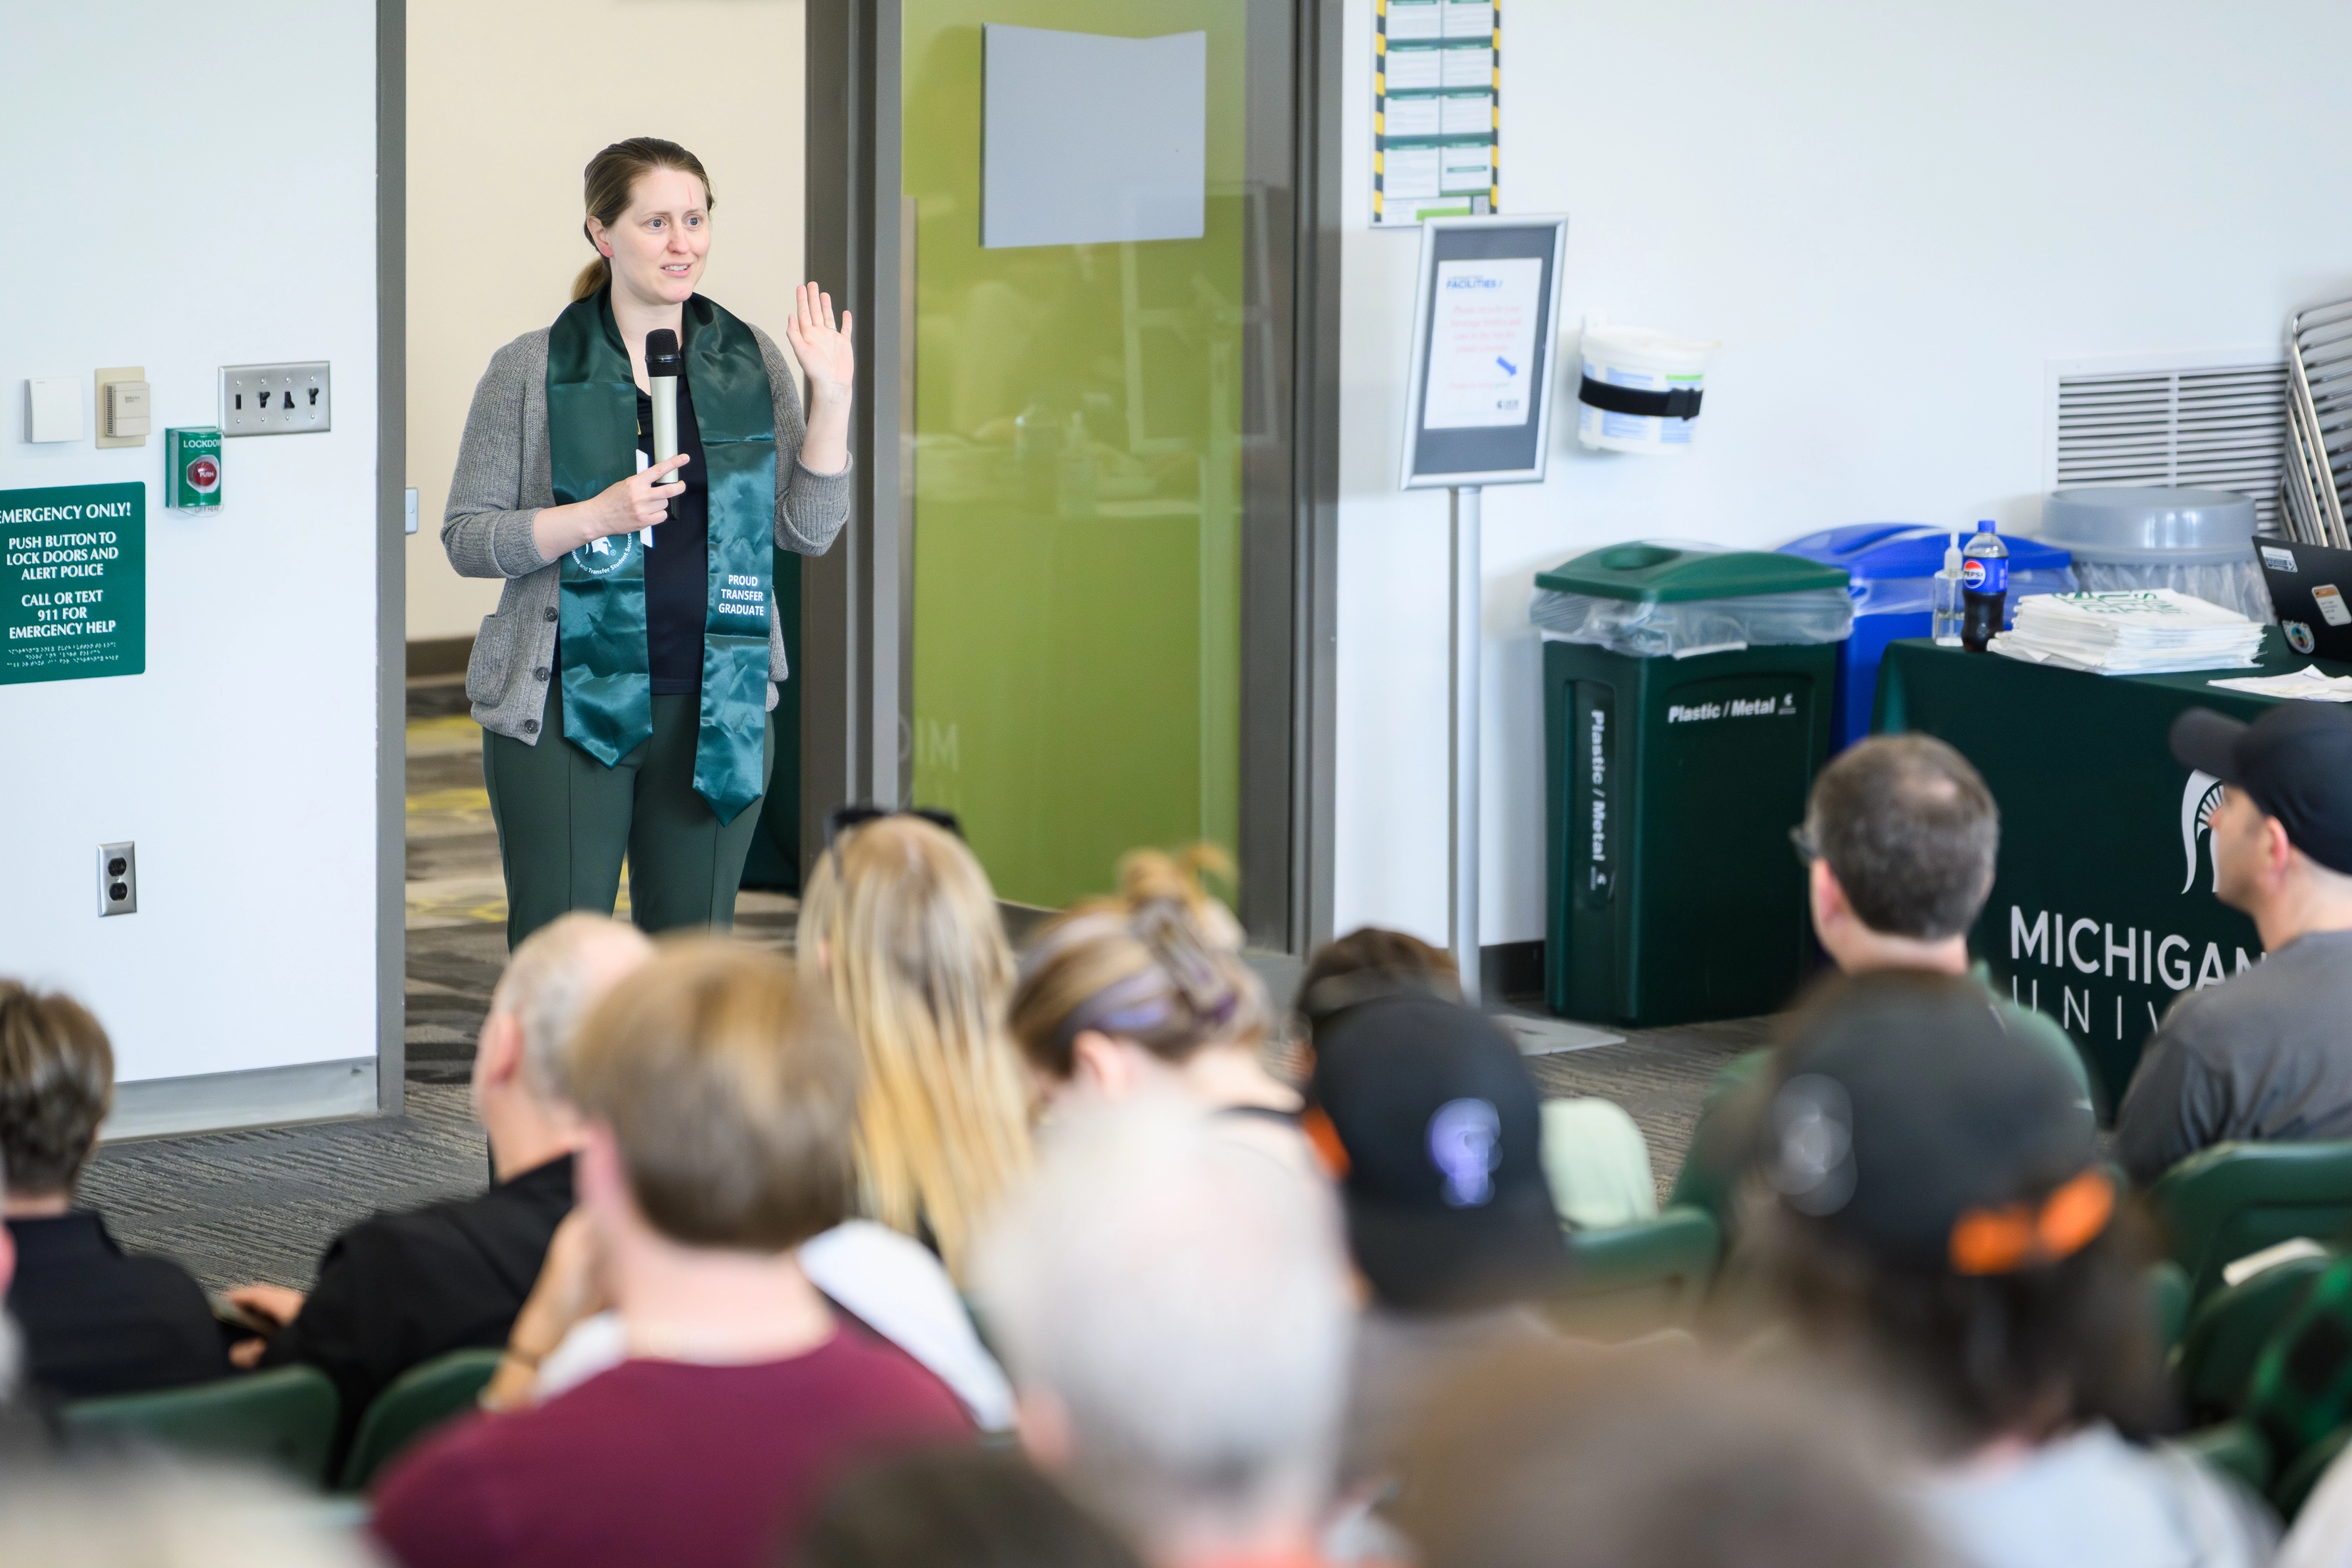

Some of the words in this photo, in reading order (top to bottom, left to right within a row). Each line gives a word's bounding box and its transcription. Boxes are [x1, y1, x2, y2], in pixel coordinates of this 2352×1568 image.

[86, 502, 131, 519] ONLY!
[9, 536, 42, 550] PUSH
[45, 532, 96, 548] BUTTON
[98, 531, 116, 544] TO
[6, 552, 41, 565] LOCK
[43, 549, 88, 563] DOORS
[90, 547, 118, 560] AND
[609, 552, 629, 570] Student
[21, 567, 58, 580] ALERT
[61, 563, 103, 577] POLICE
[728, 574, 758, 587] PROUD
[21, 592, 51, 607] CALL
[54, 592, 73, 604] OR
[75, 589, 104, 603] TEXT
[721, 588, 763, 602] TRANSFER
[38, 609, 58, 621] 911
[63, 607, 87, 619] FOR
[718, 602, 764, 616] GRADUATE
[9, 622, 83, 639] EMERGENCY
[86, 620, 116, 634] HELP
[1668, 701, 1721, 723] Plastic
[1731, 696, 1776, 717] Metal
[1591, 709, 1606, 785] Plastic
[1592, 800, 1606, 861] Metal
